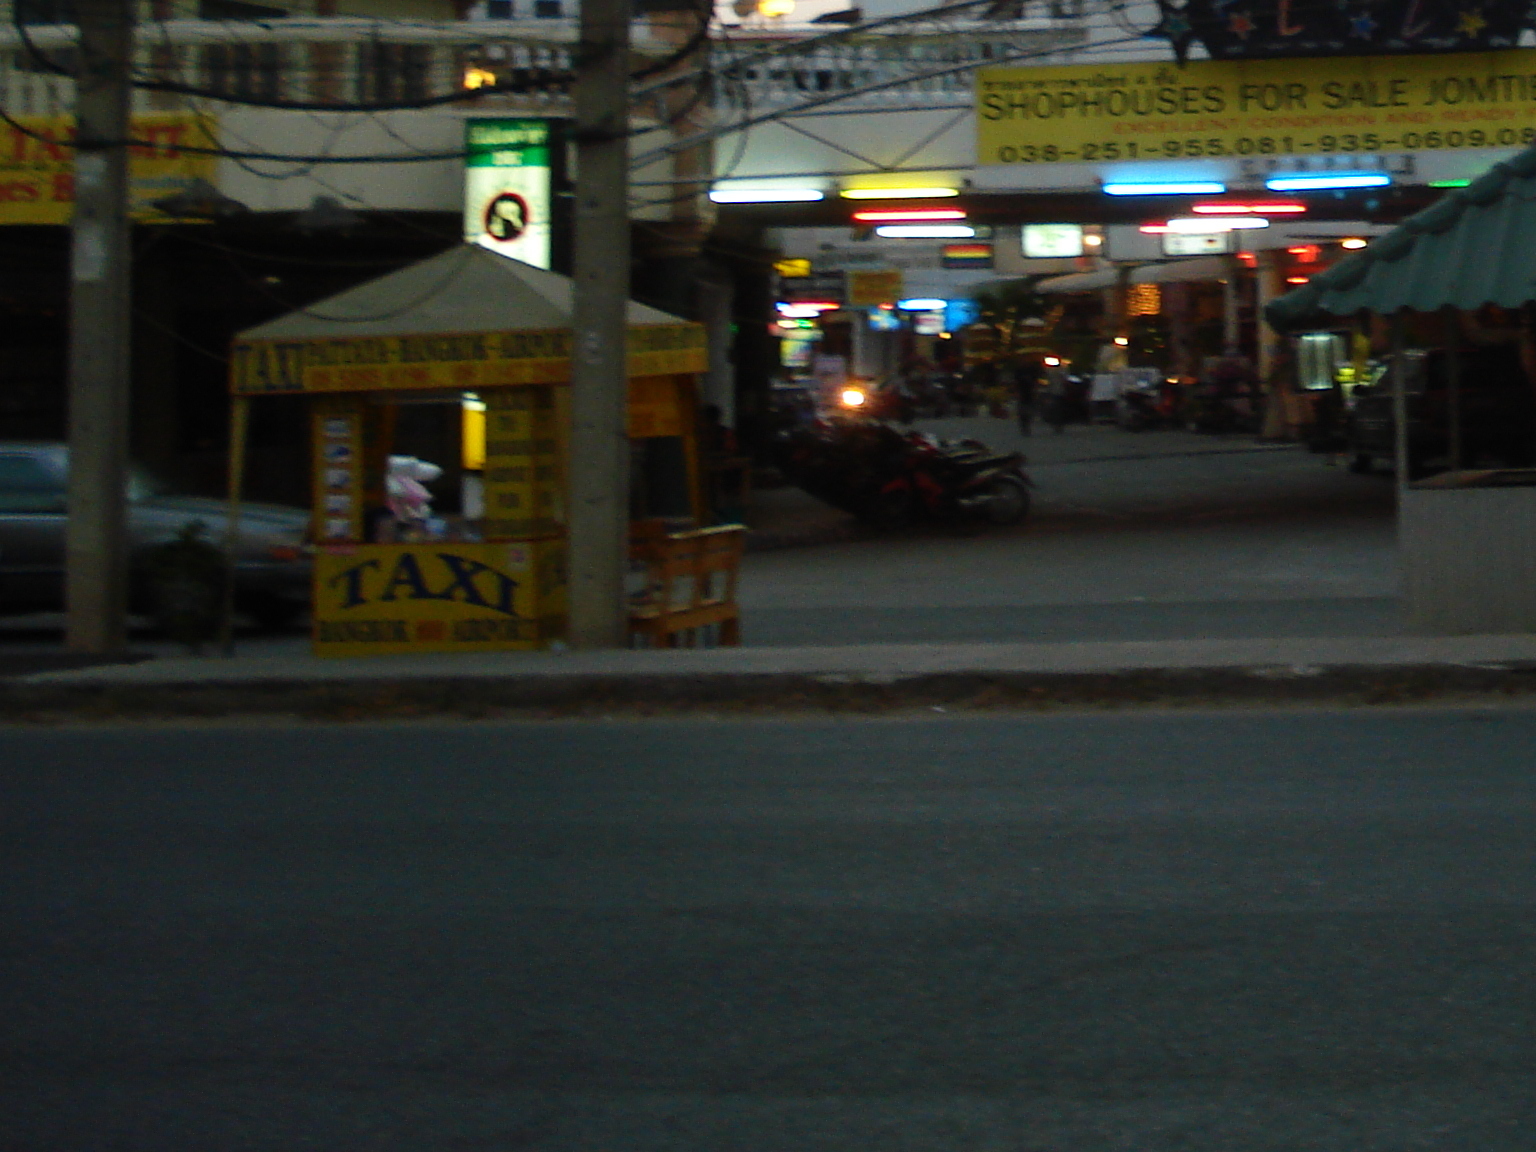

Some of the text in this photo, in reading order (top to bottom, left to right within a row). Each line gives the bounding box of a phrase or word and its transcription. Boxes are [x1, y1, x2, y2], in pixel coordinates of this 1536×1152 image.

[982, 85, 1226, 121] SHOPHOUSES
[1239, 82, 1307, 113] FOR
[1322, 78, 1409, 108] SALE
[328, 552, 520, 616] TAXI
